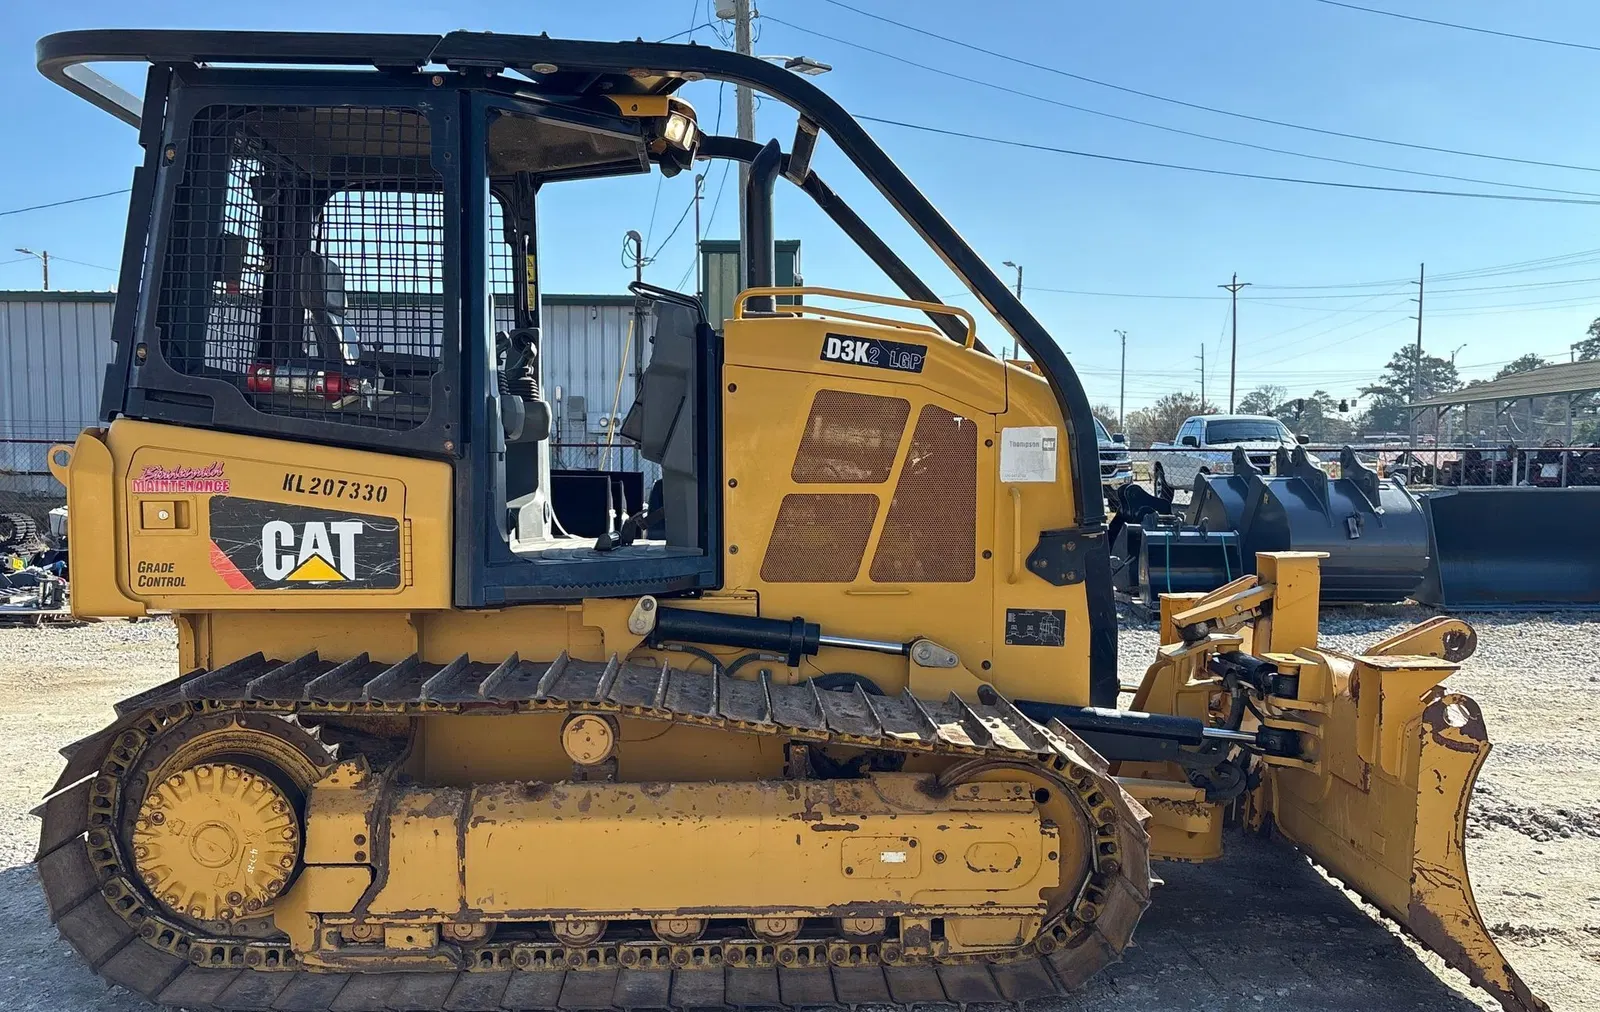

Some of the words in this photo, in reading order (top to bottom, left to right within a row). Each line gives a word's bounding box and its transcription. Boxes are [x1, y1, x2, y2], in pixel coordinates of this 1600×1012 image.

[826, 337, 880, 365] D3K2
[889, 350, 922, 369] LGP
[1009, 440, 1040, 448] Thompson
[131, 479, 230, 493] MAINTENANCE
[282, 473, 388, 502] KL207330
[262, 520, 363, 580] CAT
[138, 560, 175, 573] GRADE
[138, 574, 187, 587] CONTROL
